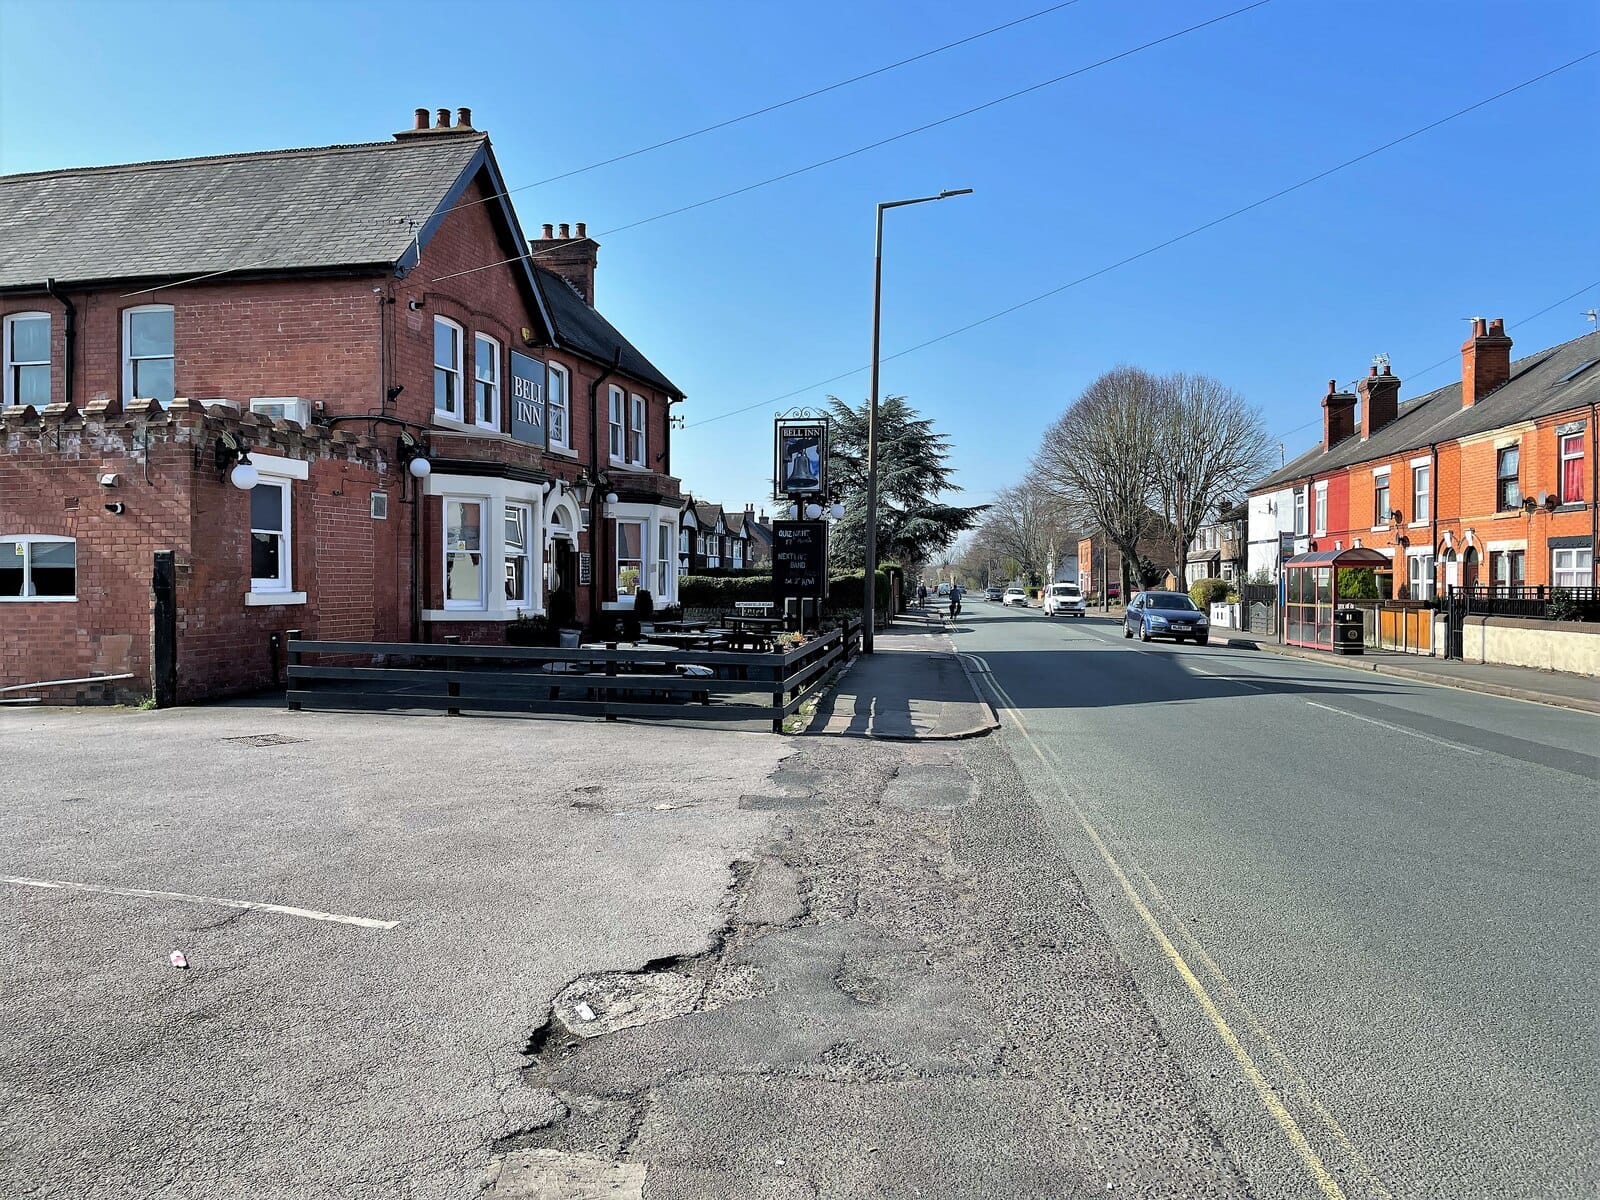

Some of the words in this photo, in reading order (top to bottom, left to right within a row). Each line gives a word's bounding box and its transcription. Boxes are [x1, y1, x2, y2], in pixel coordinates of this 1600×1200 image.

[513, 375, 545, 405] BELL
[516, 400, 542, 427] INN
[783, 429, 803, 437] BELL
[804, 429, 820, 437] INN
[778, 529, 793, 538] QUIZ
[777, 552, 794, 560] NEXT
[790, 561, 806, 569] BAND
